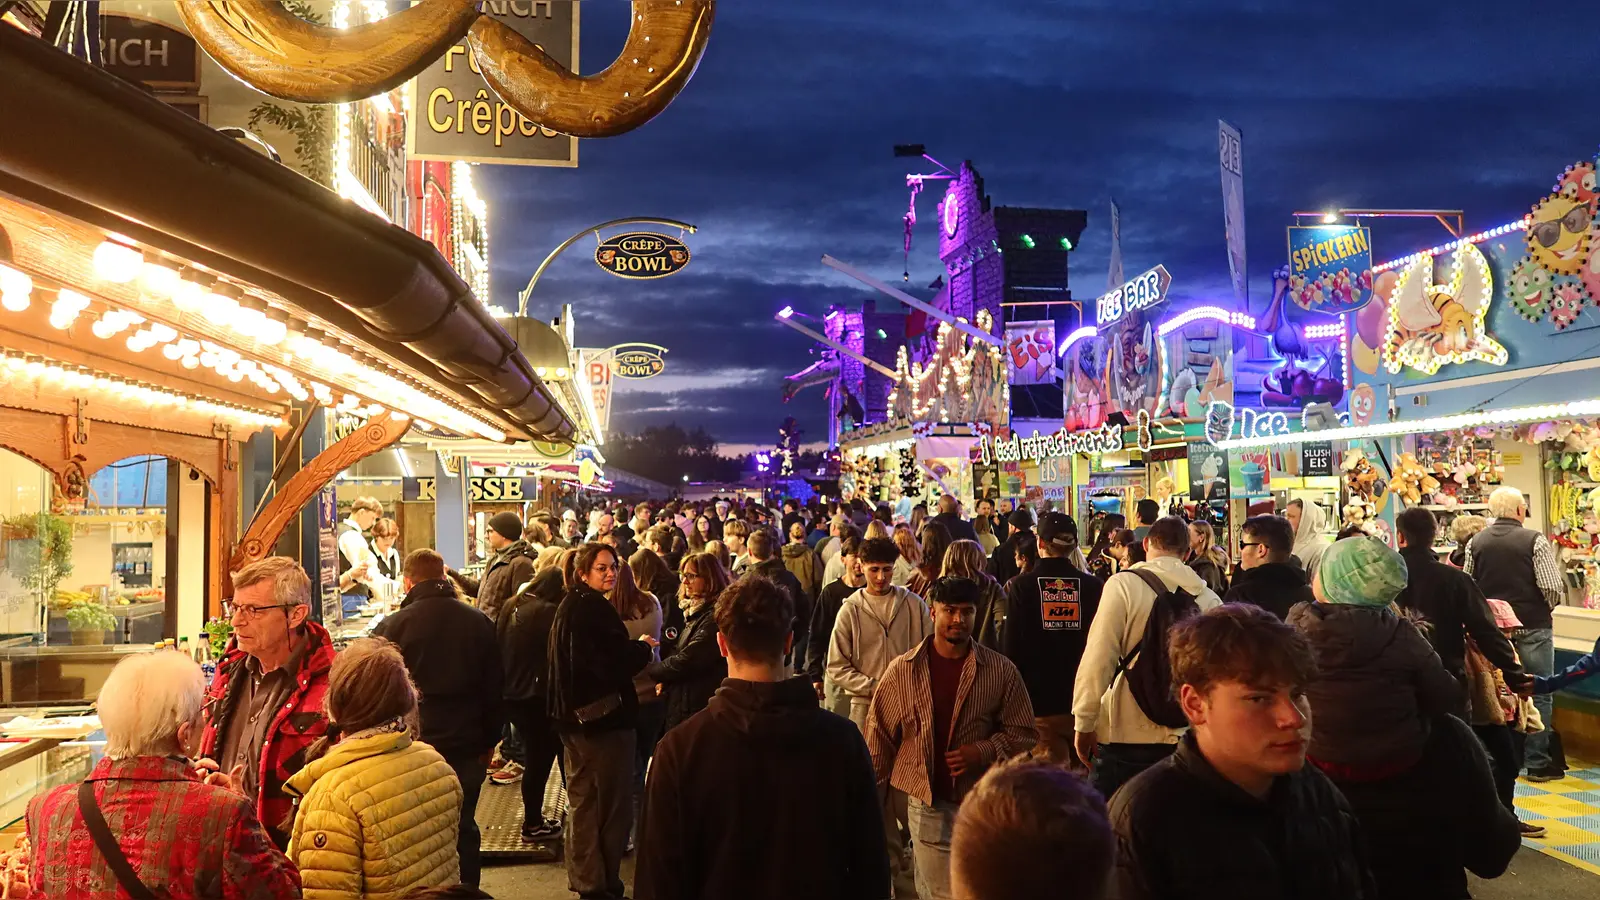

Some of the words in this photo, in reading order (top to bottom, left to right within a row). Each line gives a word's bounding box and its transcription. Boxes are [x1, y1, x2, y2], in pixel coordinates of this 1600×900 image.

[622, 239, 662, 251] CRÊPE
[615, 256, 671, 272] BOWL
[1097, 289, 1123, 324] ICE
[1124, 270, 1160, 312] BAR
[620, 365, 652, 375] BOWL
[994, 433, 1021, 462] Cool
[1021, 422, 1122, 465] refreshments
[1304, 449, 1331, 457] SLUSH
[1310, 458, 1327, 467] EIS
[1042, 458, 1056, 481] EIS
[417, 478, 523, 500] KSSE
[1043, 591, 1060, 601] Red
[1061, 591, 1078, 601] Bull
[1049, 606, 1075, 616] KTM
